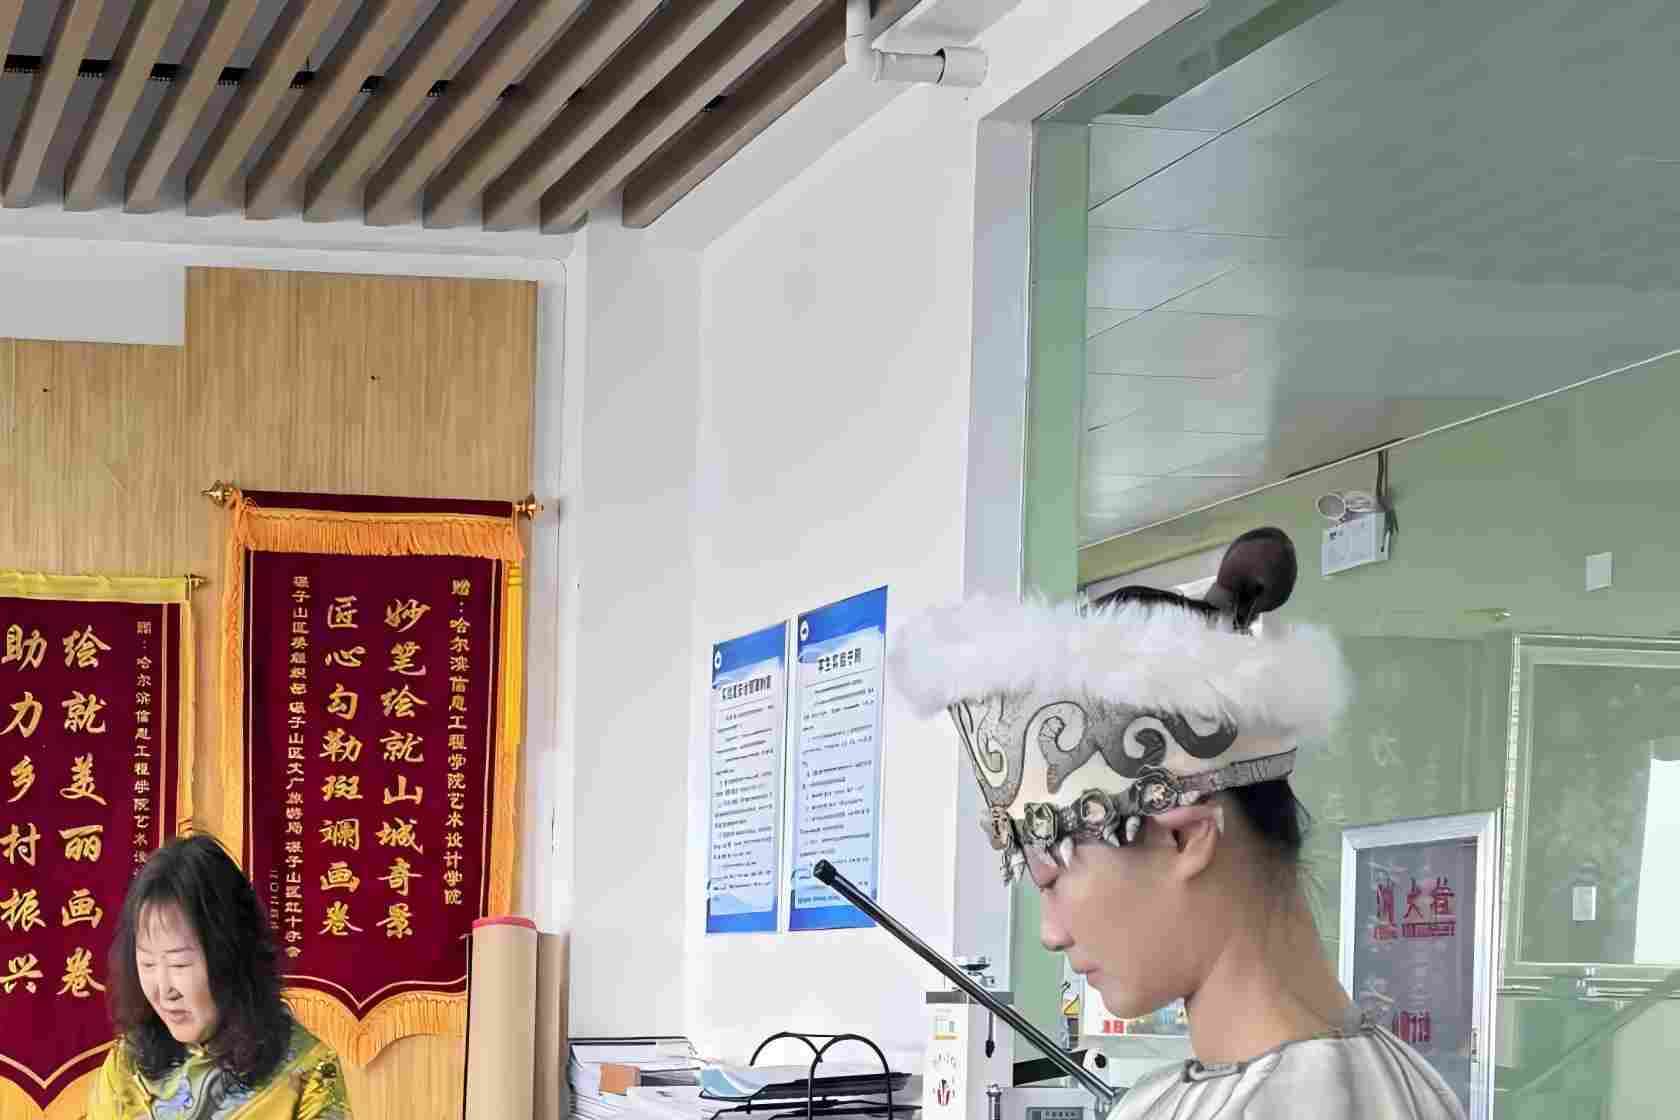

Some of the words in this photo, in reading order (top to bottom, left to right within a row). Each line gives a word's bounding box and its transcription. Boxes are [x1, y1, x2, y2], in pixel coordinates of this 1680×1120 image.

[56, 625, 112, 997] 绘就美丽画卷
[318, 595, 368, 936] 匠心勾勒斑斓画卷
[375, 597, 432, 939] 妙笔绘就山城奇景
